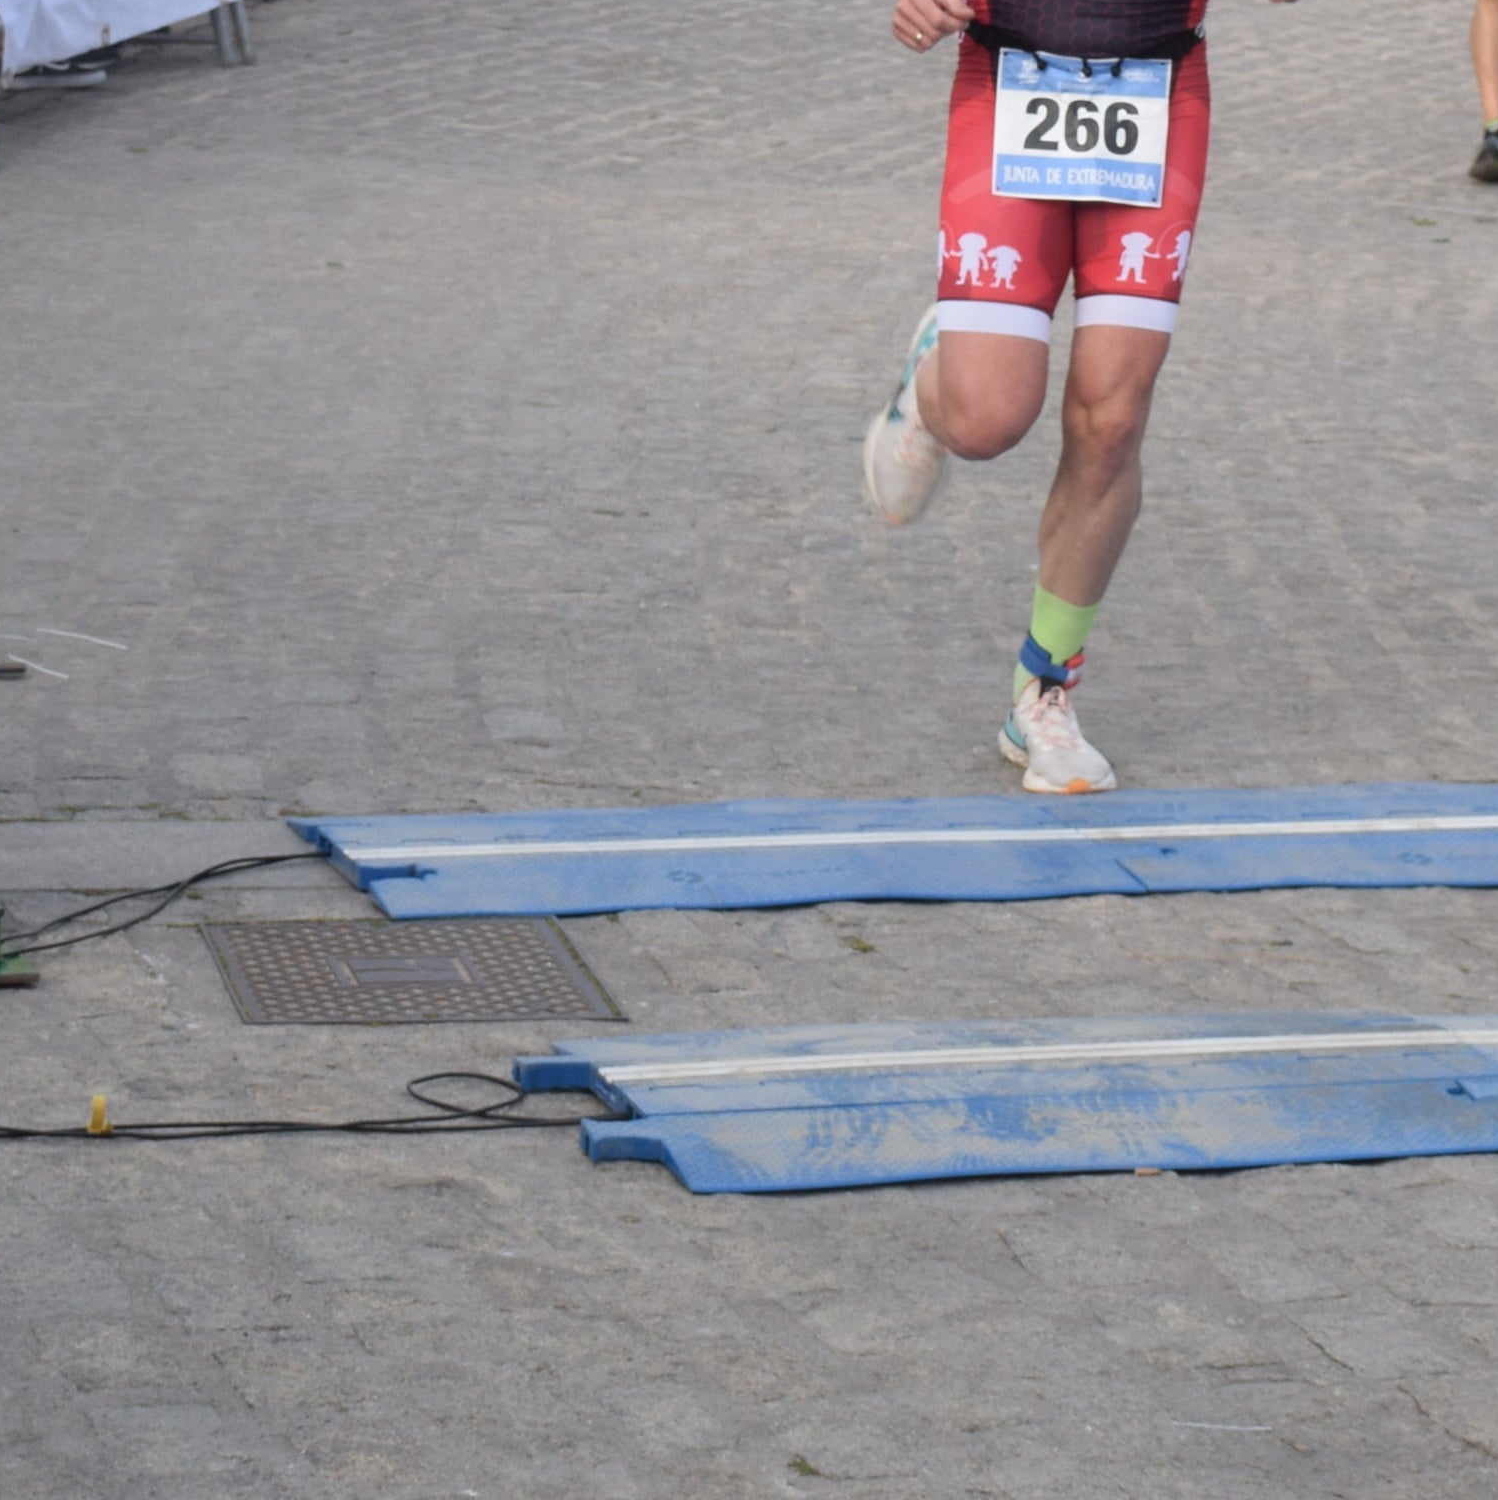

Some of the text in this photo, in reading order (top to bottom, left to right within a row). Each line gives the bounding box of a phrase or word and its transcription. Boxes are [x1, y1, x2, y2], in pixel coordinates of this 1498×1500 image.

[1023, 97, 1139, 156] 266
[1003, 164, 1156, 192] JUNTA DE EXTREMADURA
